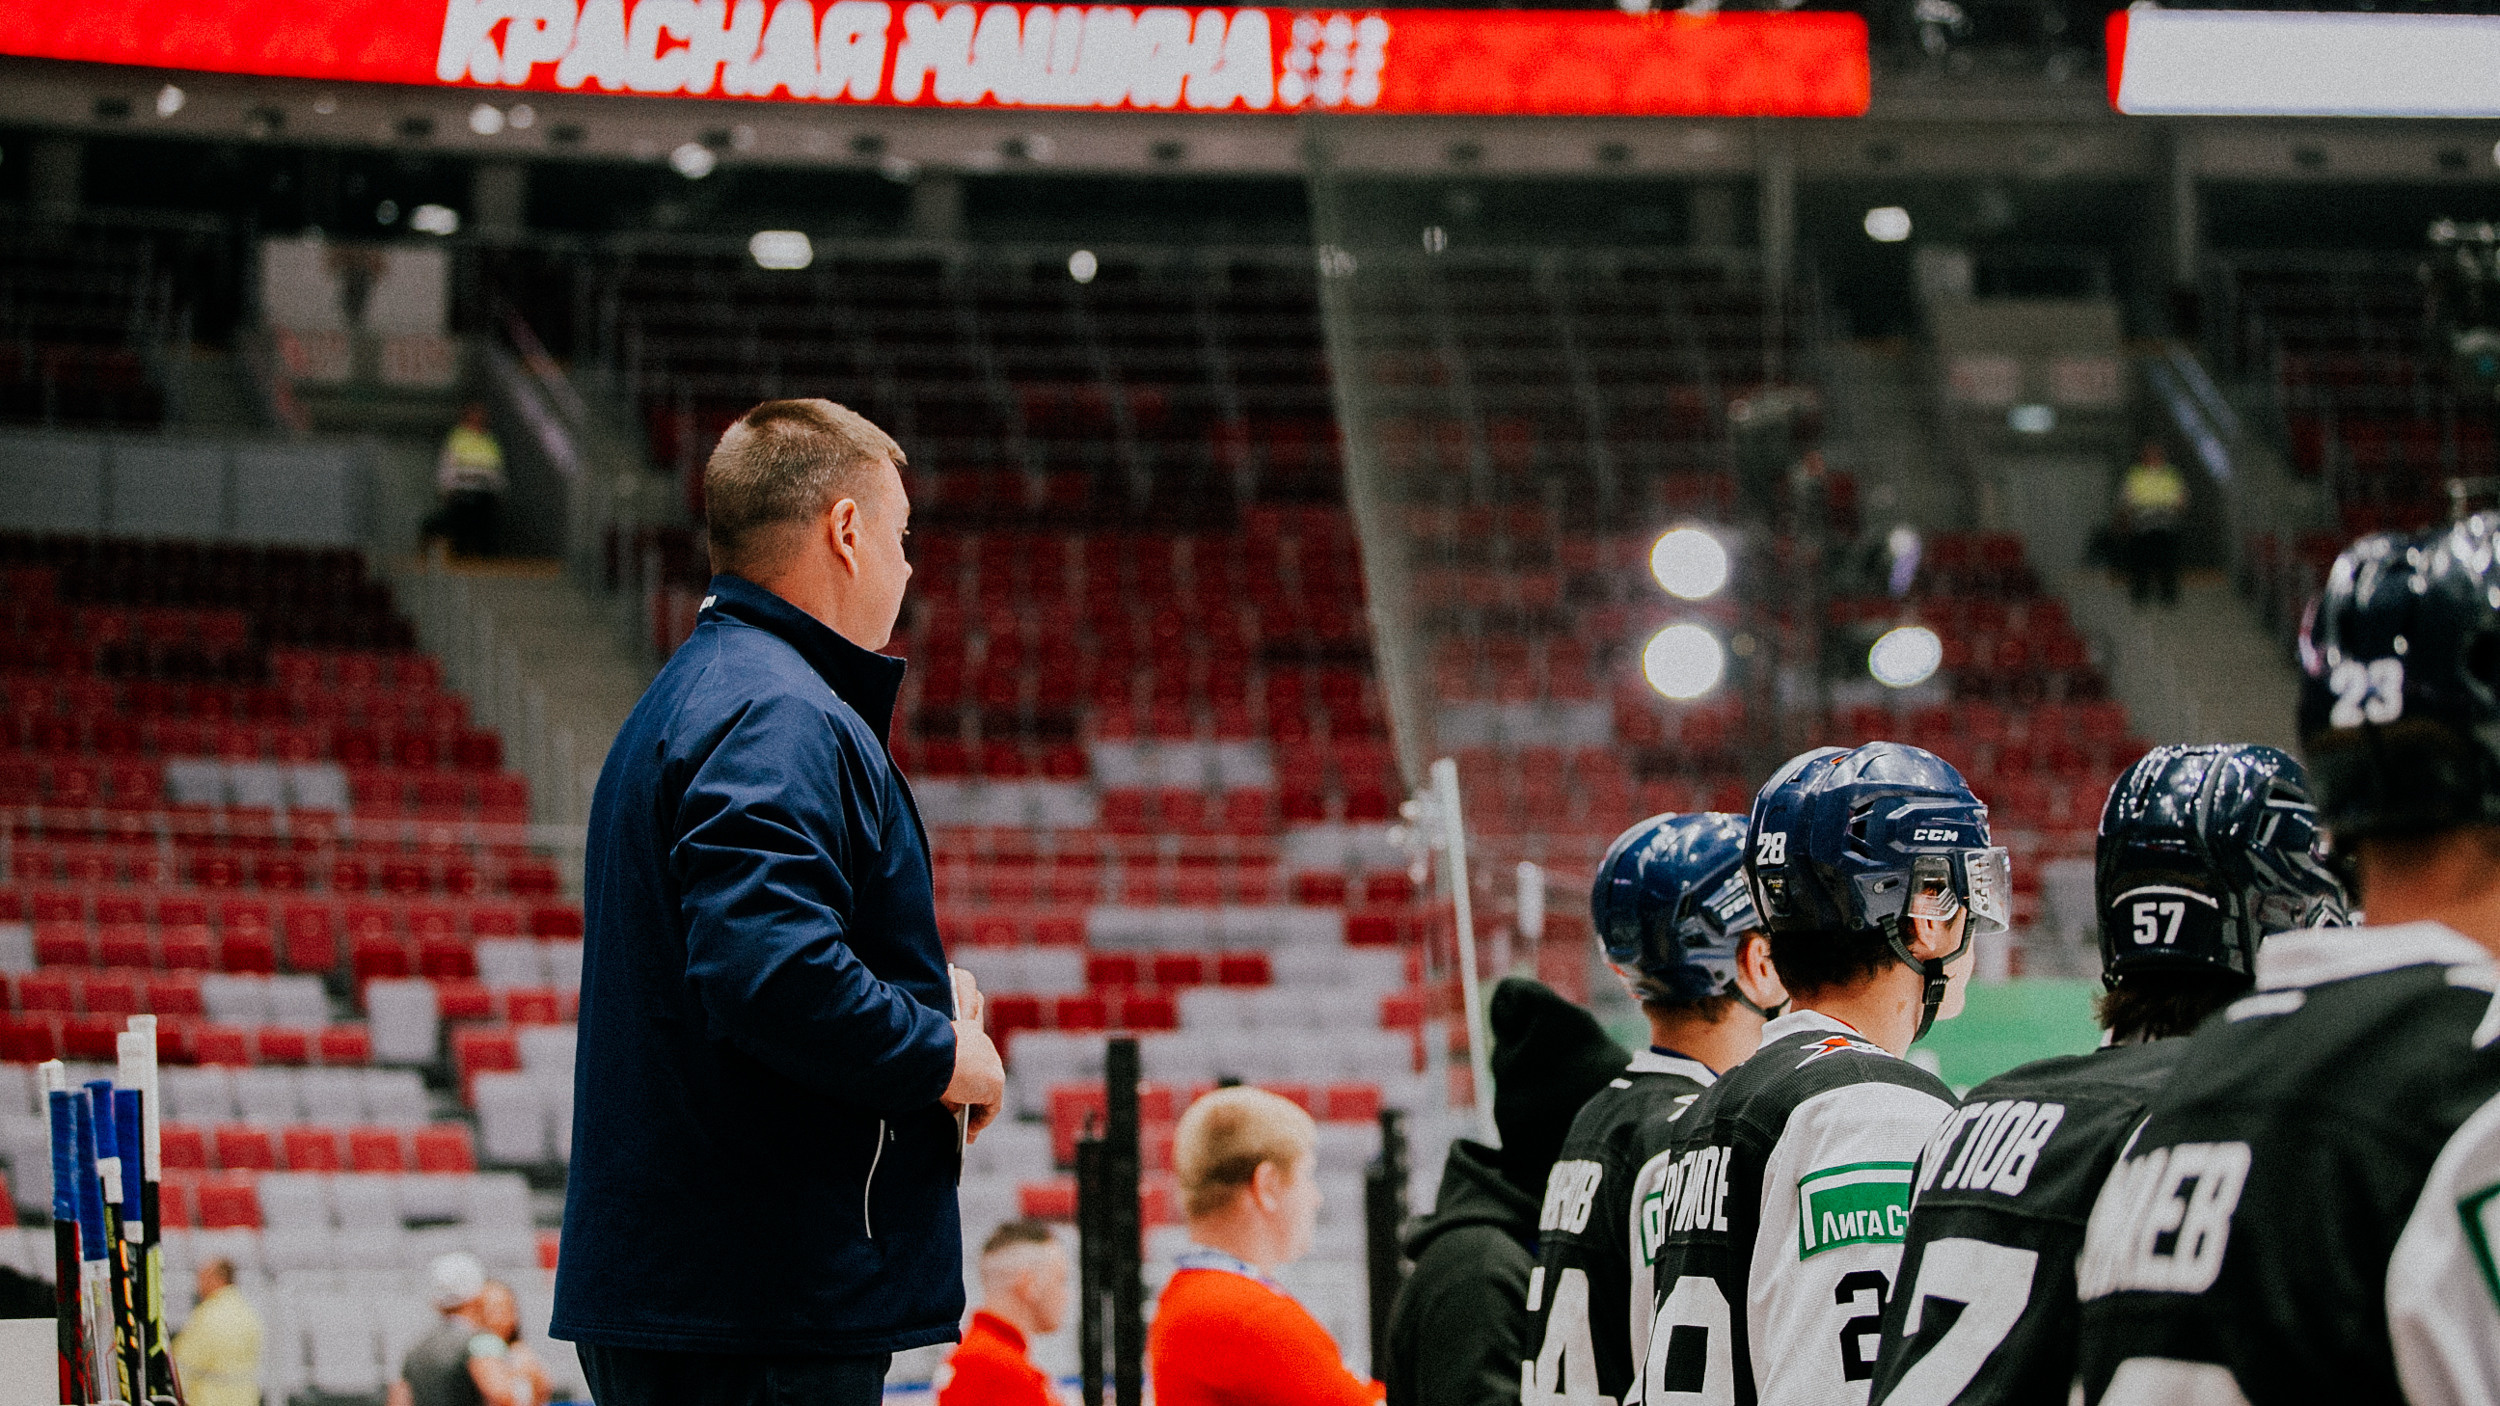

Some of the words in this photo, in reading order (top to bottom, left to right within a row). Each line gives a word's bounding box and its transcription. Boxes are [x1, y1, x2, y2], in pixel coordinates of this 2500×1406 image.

[436, 0, 892, 100] КРАСНАЯ
[891, 3, 1274, 109] МАШИНА
[2330, 659, 2404, 728] 23
[1756, 832, 1787, 866] 28
[1913, 829, 1959, 842] CCM
[2133, 902, 2185, 944] 57
